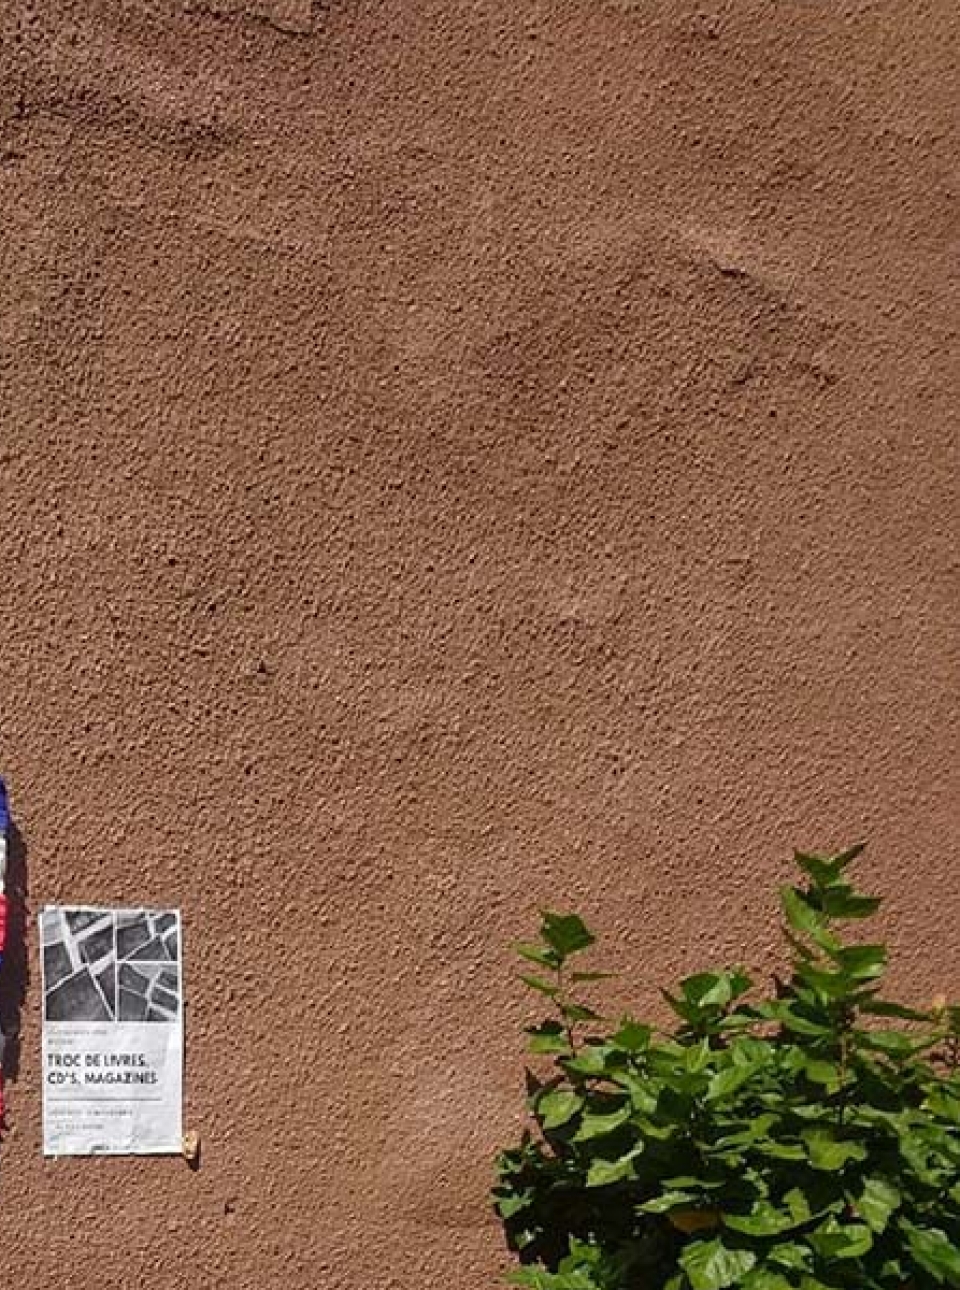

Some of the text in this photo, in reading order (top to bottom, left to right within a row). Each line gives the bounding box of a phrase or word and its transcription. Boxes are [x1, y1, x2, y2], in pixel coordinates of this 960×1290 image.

[47, 1053, 82, 1067] TROC
[85, 1054, 101, 1067] DE
[84, 1072, 158, 1085] MAGAZINES
